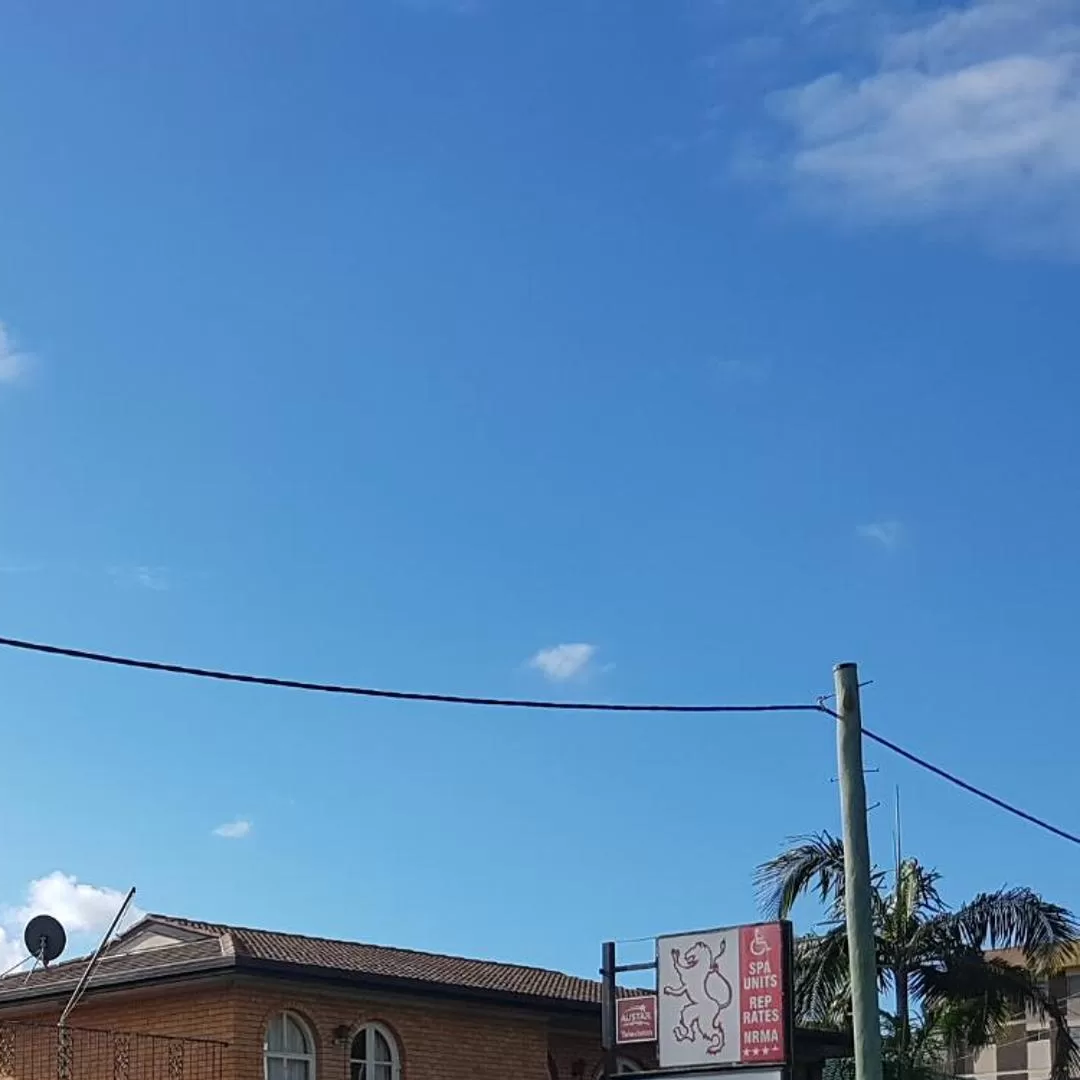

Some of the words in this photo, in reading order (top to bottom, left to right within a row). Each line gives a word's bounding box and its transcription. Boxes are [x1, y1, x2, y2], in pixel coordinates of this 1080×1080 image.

[748, 960, 771, 976] SPA
[743, 974, 777, 990] UNITS
[749, 995, 772, 1010] REP
[743, 1009, 779, 1025] RATES
[743, 1029, 779, 1044] NRMA
